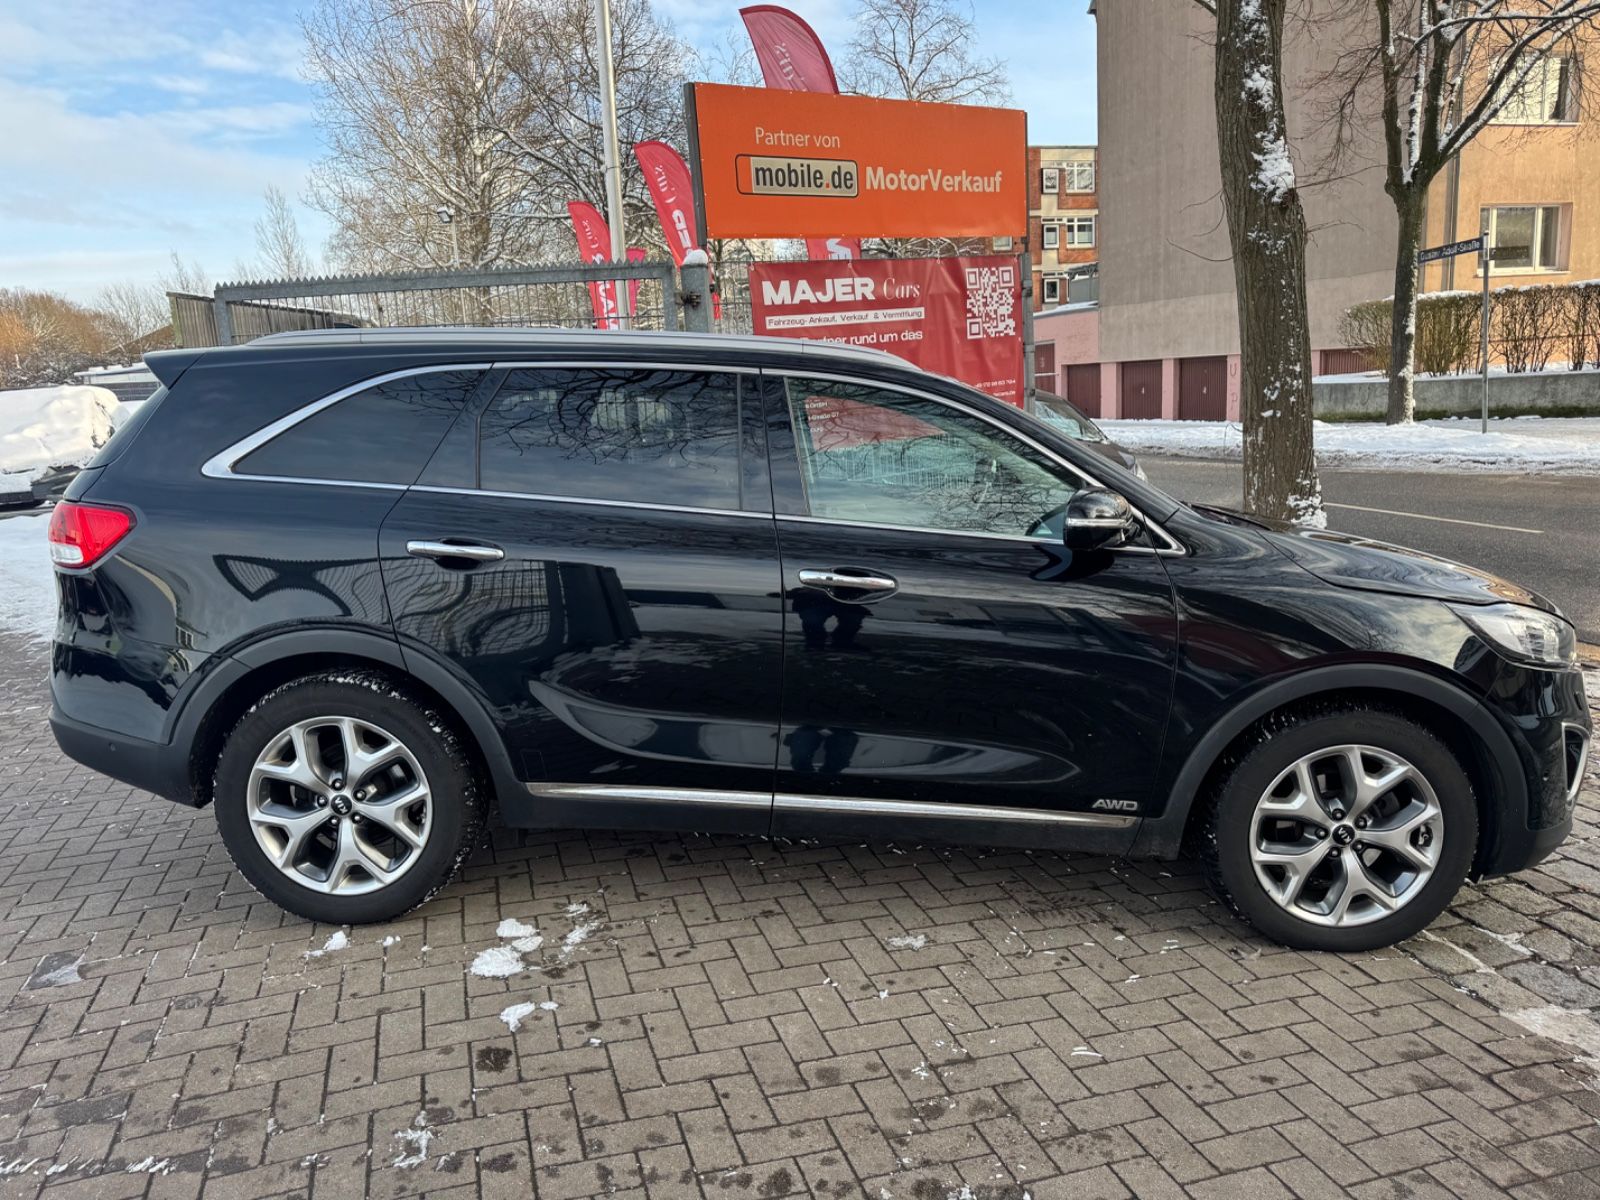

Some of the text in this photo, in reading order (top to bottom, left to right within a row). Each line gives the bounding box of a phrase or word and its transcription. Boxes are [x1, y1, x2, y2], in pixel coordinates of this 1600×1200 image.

[755, 126, 841, 149] Partner von
[754, 162, 1002, 193] mobile.de MotorVerkauf
[761, 277, 921, 306] MAJER Cars
[840, 313, 869, 322] Verkauf
[873, 312, 880, 320] &
[882, 310, 922, 320] Vermittlung
[850, 332, 877, 345] rund
[879, 334, 898, 343] um
[901, 330, 923, 341] das
[1091, 798, 1138, 811] AWD
